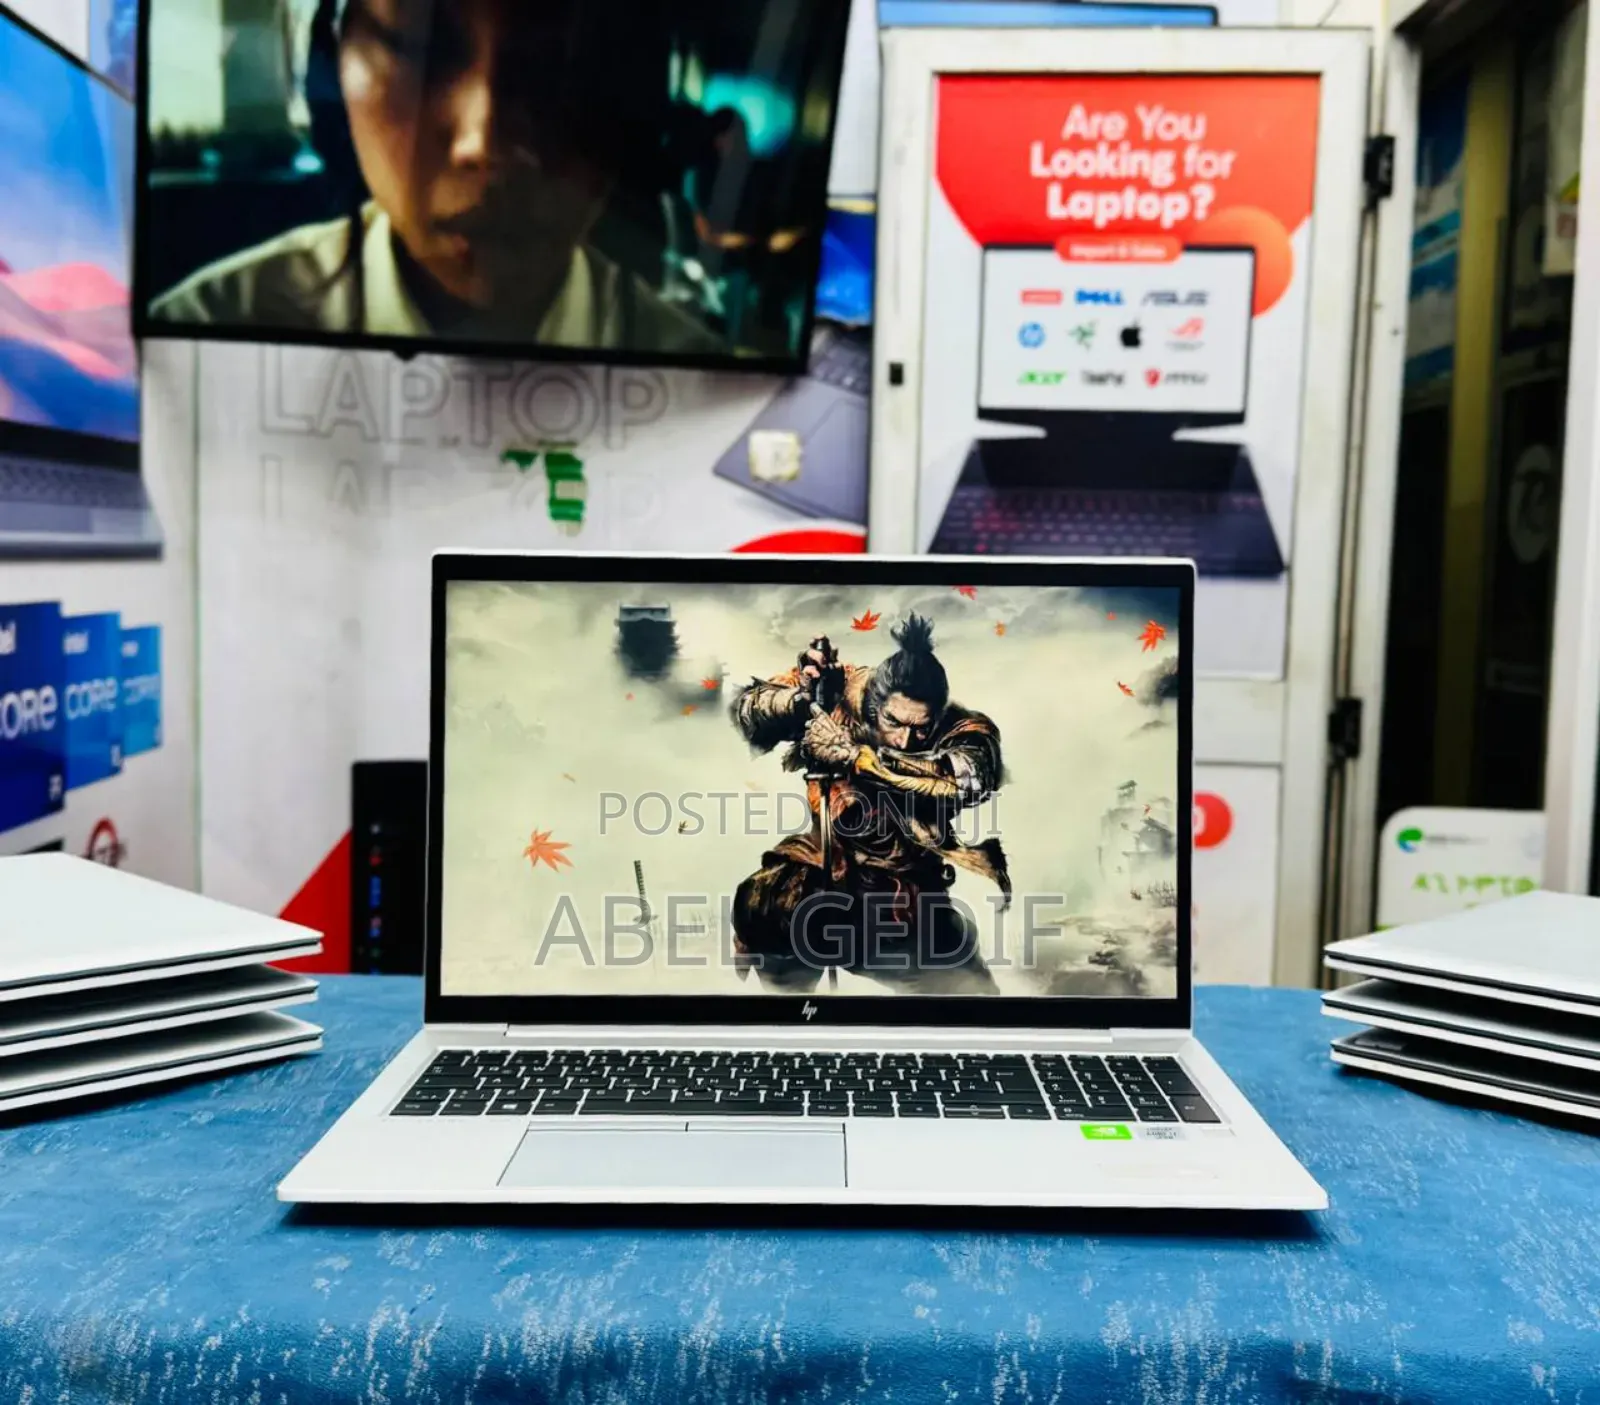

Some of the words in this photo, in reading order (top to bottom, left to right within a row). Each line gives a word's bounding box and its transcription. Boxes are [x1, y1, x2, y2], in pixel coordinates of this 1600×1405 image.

[1061, 103, 1128, 141] Are
[1134, 103, 1207, 142] You
[1030, 141, 1177, 188] Looking
[1183, 142, 1237, 180] for
[1046, 182, 1215, 229] Laptop?
[258, 342, 669, 449] LAPTOP
